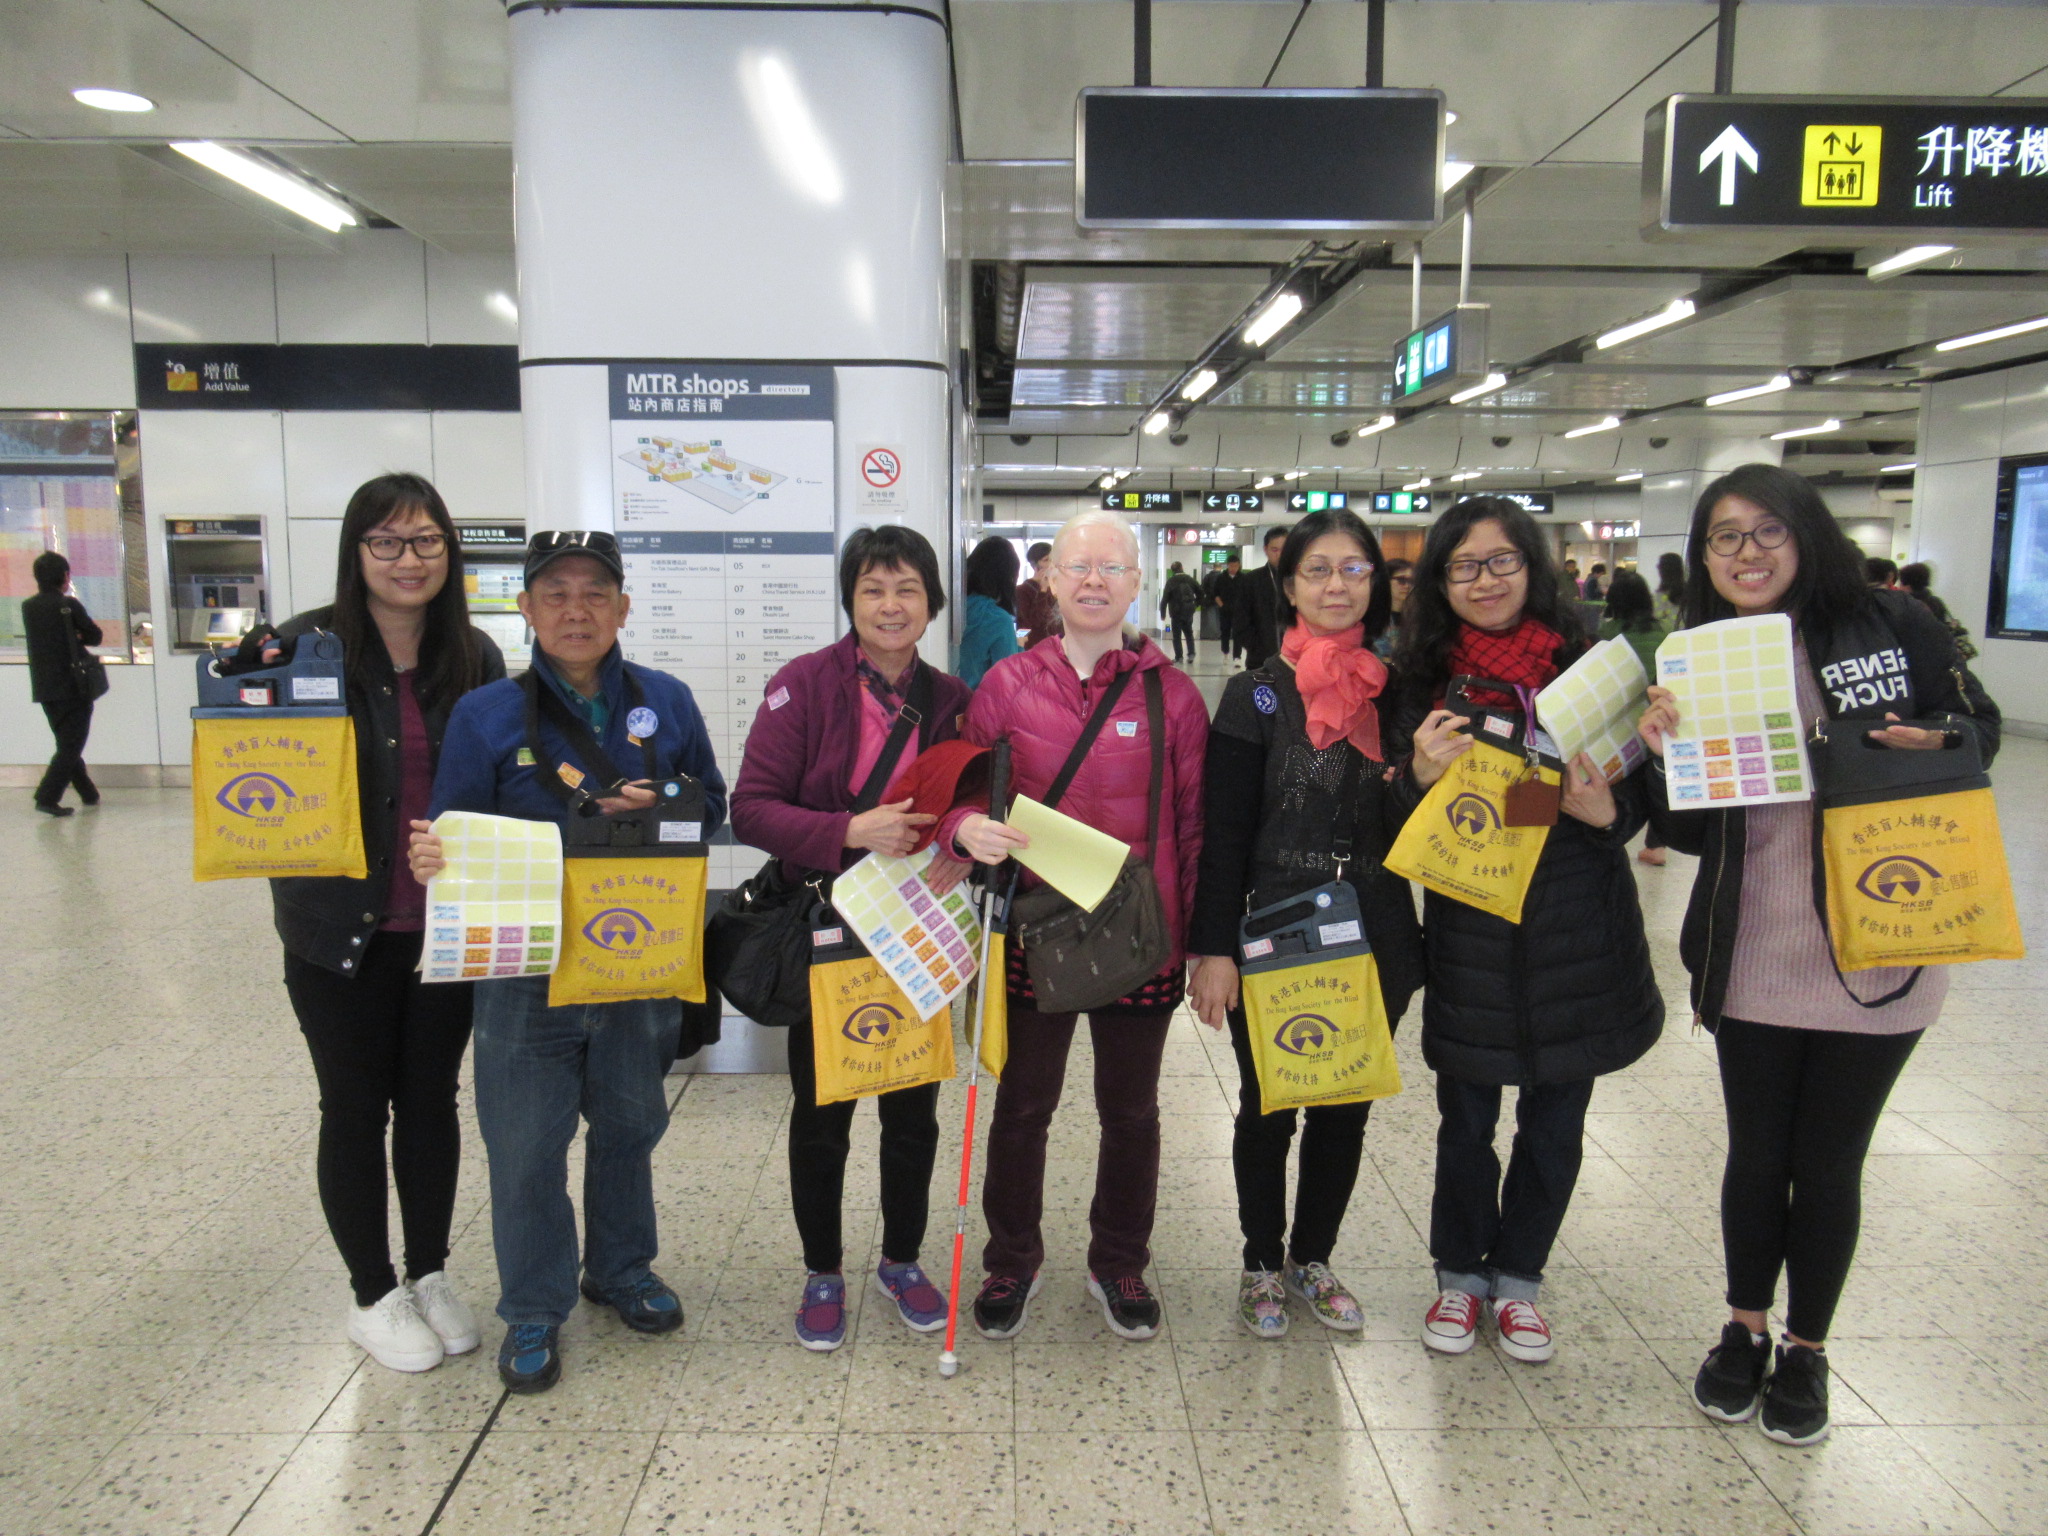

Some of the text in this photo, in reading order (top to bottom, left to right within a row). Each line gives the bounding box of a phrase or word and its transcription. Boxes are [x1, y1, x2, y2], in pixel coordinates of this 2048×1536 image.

[1914, 184, 1953, 208] Lift
[204, 362, 240, 380] 增值
[205, 382, 250, 391] Add Value
[627, 373, 750, 399] MTR shops
[766, 386, 806, 394] directory
[628, 397, 723, 413] 站內商店指南
[733, 562, 743, 570] 05
[222, 735, 318, 759] 香港盲人輔導會
[258, 761, 281, 769] Society
[1851, 812, 1959, 845] 香港盲人輔導會
[1459, 836, 1486, 849] HKSB
[1876, 845, 1891, 853] Kong
[1892, 842, 1918, 850] Society
[1936, 838, 1947, 846] the
[1949, 834, 1970, 844] Blind
[590, 874, 678, 895] 香港盲人輔導會
[623, 897, 643, 905] Society
[1900, 899, 1934, 909] HKSB
[870, 991, 890, 999] Society
[1270, 975, 1351, 1006] 香港盲人輔導會
[1302, 1001, 1321, 1009] Society
[1344, 995, 1359, 1003] Blind
[874, 1038, 898, 1048] HKSB
[1309, 1050, 1334, 1060] HKSB
